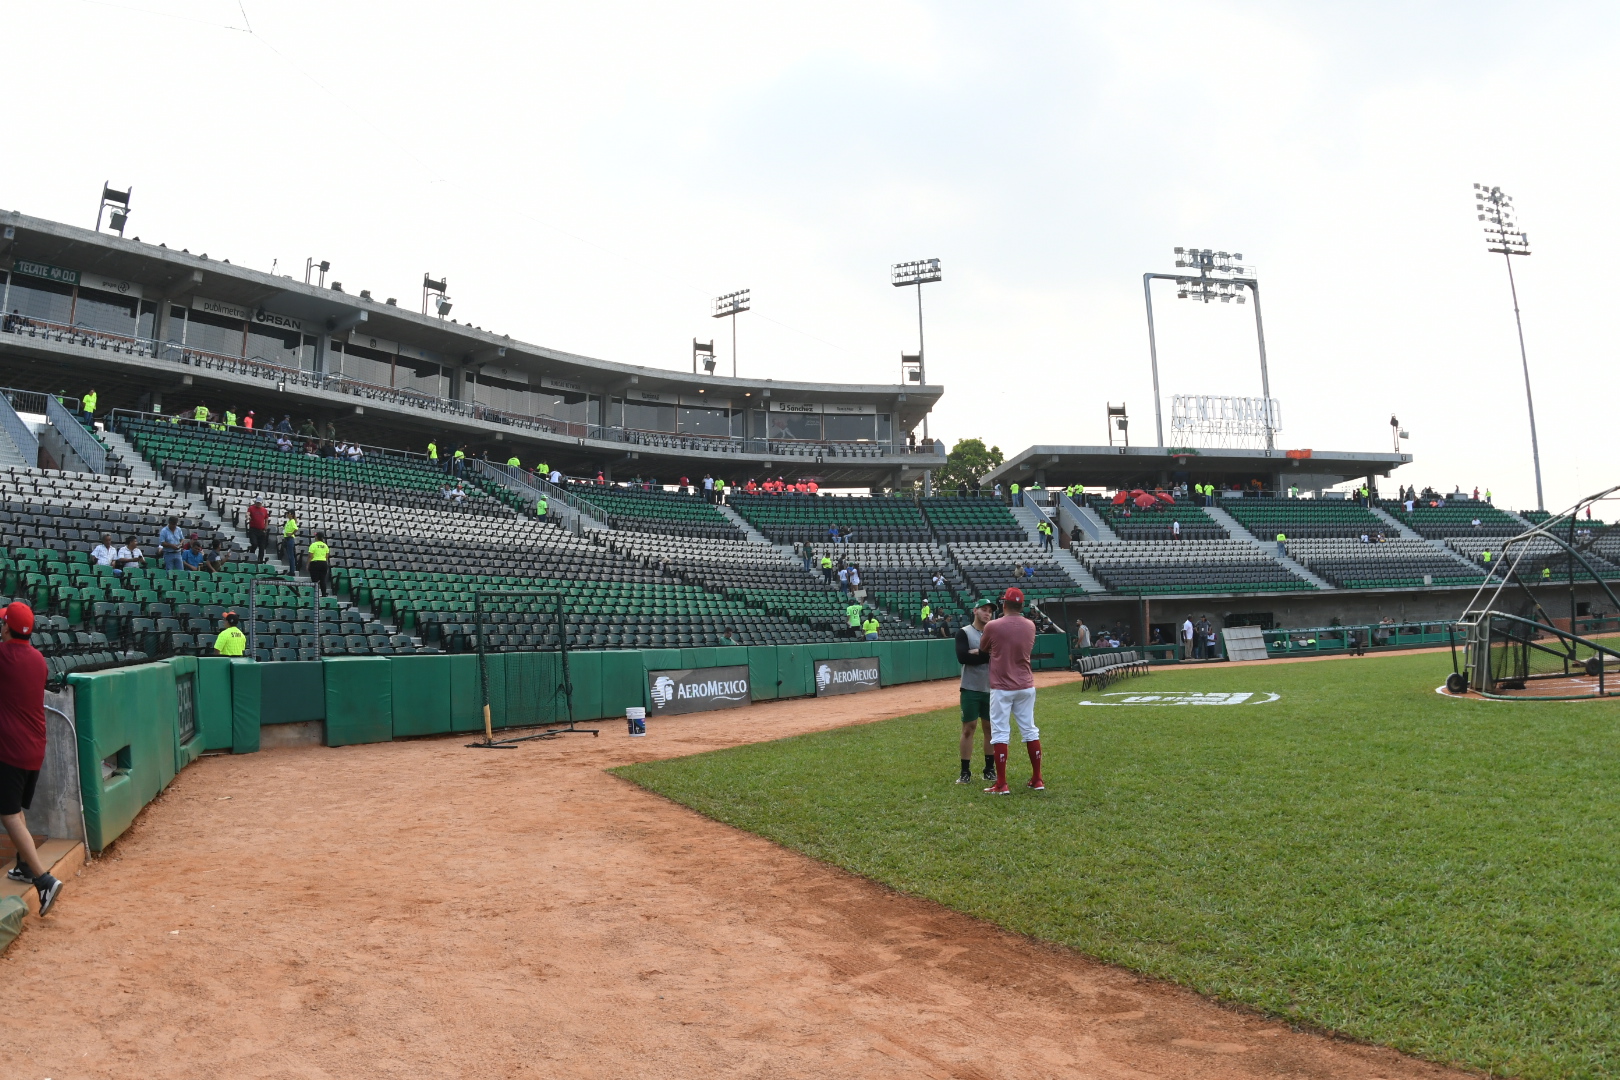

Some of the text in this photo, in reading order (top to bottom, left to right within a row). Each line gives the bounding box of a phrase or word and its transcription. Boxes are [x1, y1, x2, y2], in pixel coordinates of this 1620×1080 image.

[18, 261, 50, 277] TECATE
[256, 307, 302, 329] ORSAN
[1172, 394, 1283, 432] CENTENARIO
[832, 668, 878, 684] AEROMEXICO
[677, 679, 748, 700] AEROMEXICO
